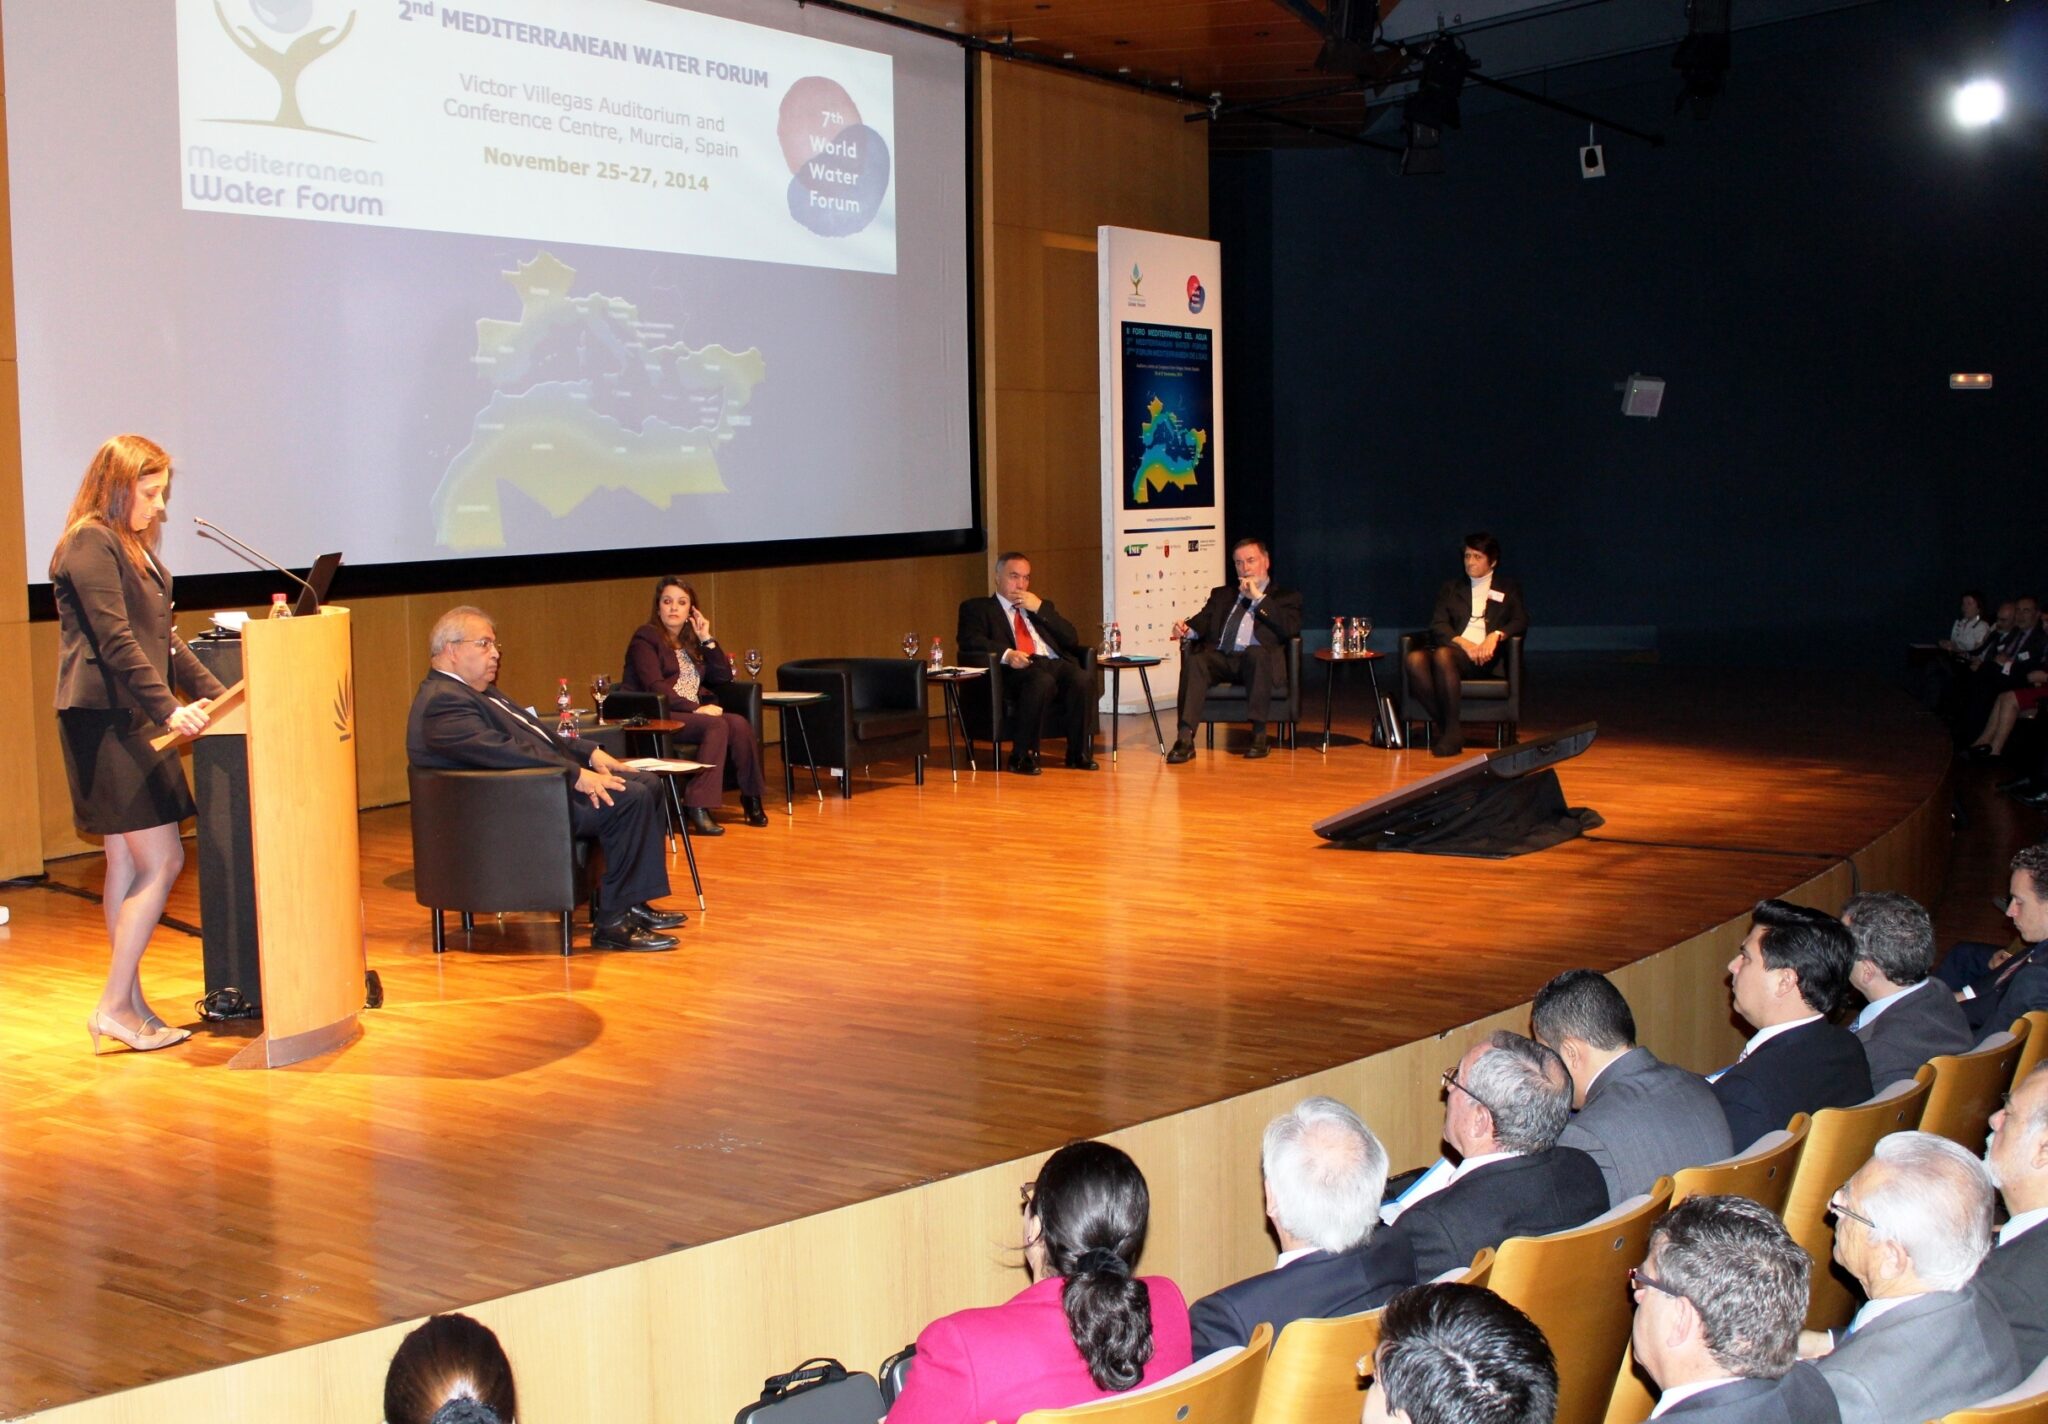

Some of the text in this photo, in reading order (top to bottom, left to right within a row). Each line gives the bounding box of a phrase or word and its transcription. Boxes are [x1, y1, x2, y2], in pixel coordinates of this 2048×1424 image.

[398, 0, 769, 88] 2nd MEDITERRANEAN WATER FORUM
[459, 73, 725, 132] Victor Villegas Auditorium and
[821, 111, 844, 128] 7th
[443, 98, 738, 159] Conference Centre, Murcia, Spain
[809, 134, 857, 159] World
[187, 145, 384, 187] Mediterranean
[483, 147, 709, 192] November 25-27, 2014
[809, 163, 859, 186] Water
[189, 174, 384, 216] Water Forum
[809, 191, 860, 213] Forum
